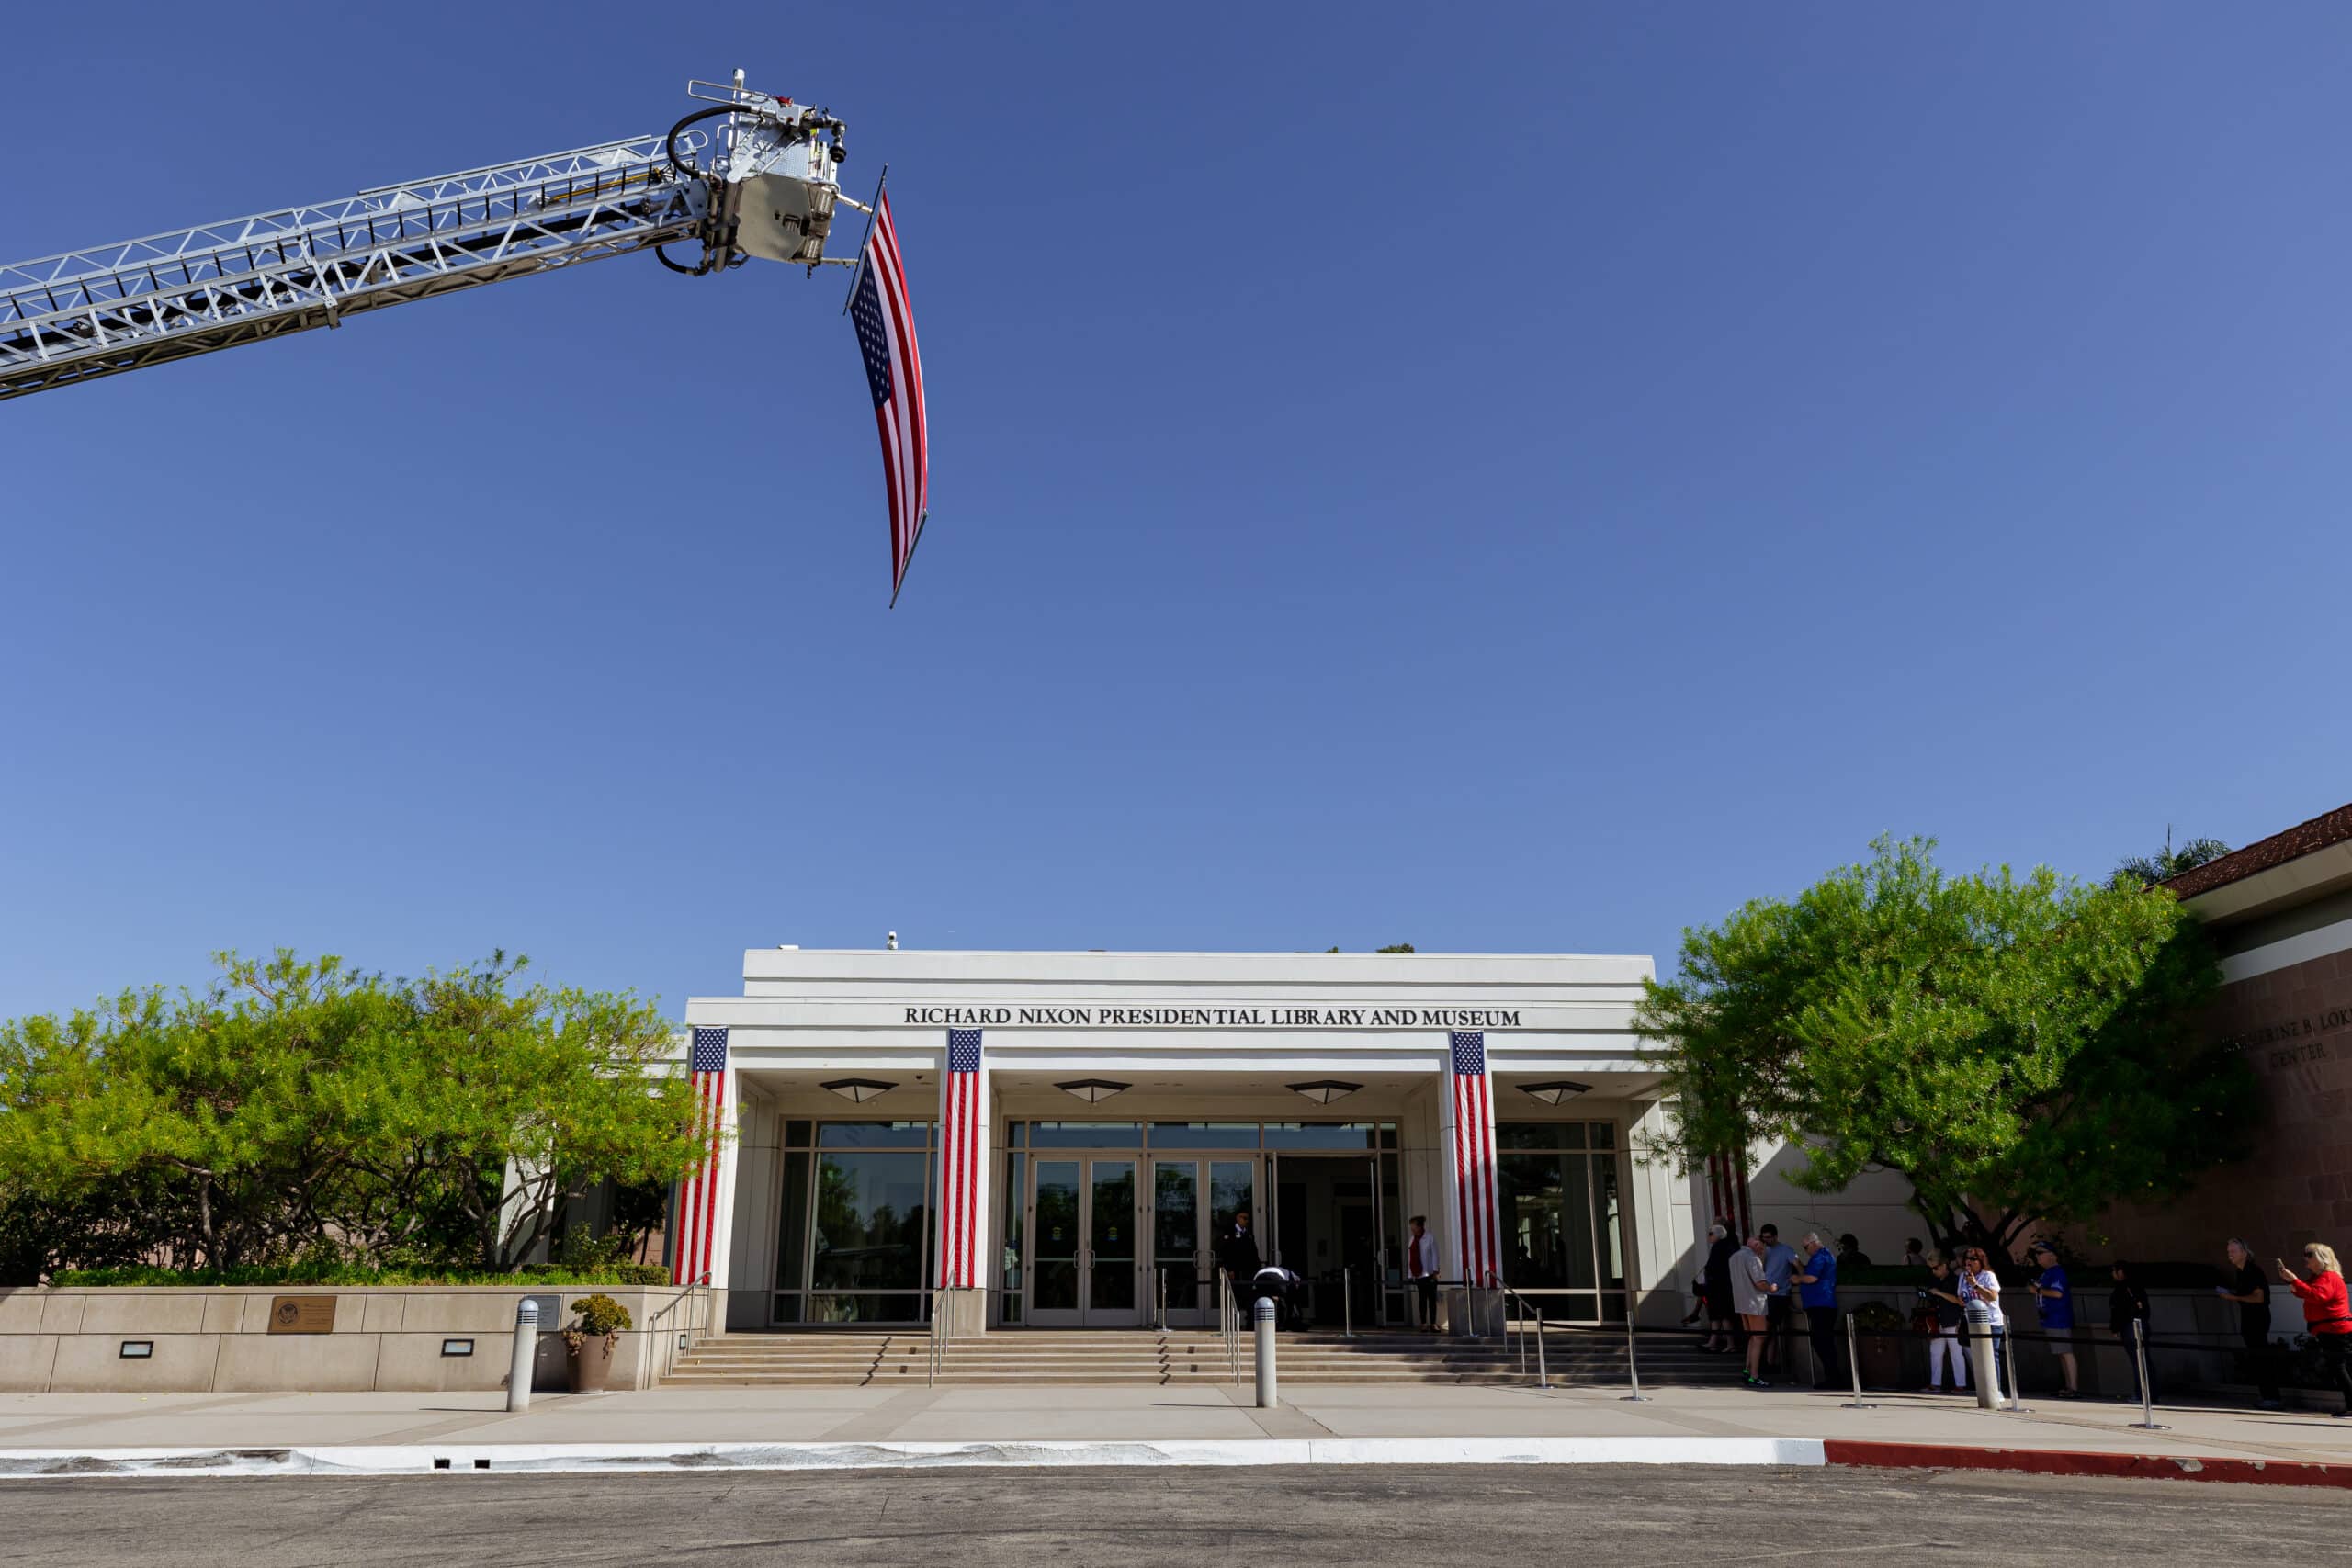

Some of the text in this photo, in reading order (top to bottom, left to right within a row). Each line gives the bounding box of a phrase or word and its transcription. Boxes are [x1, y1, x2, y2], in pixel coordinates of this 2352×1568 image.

[904, 1008, 1521, 1026] RICHARD NIXON PRESIDENTIAL LIBRARY AND MUSEUM
[2319, 1008, 2352, 1030] LOK
